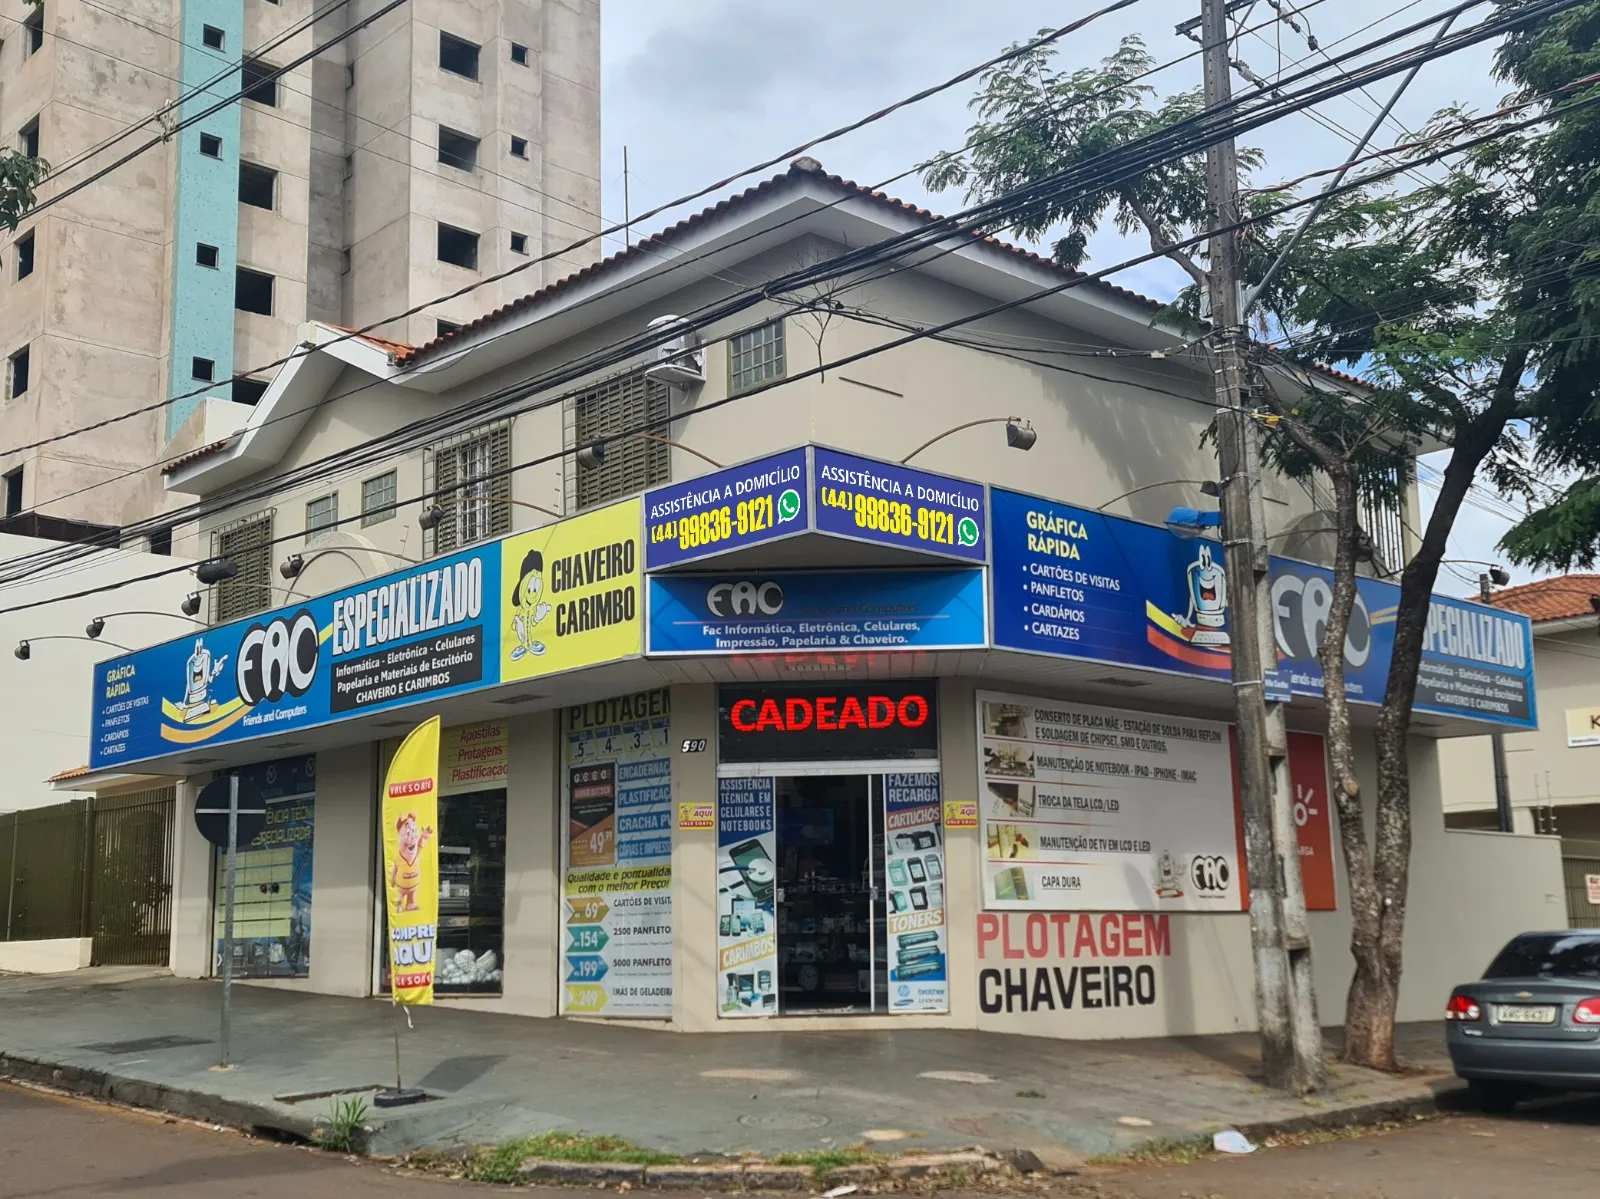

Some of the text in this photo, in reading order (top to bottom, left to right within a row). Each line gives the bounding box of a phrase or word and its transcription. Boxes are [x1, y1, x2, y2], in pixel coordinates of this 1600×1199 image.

[651, 465, 800, 519] ASSISTÊNCIA A DOMICÍLIO
[821, 465, 979, 511] ASSISTÊNCIA A DOMICÍLIO
[651, 495, 773, 550] (44) 99836-9121
[821, 487, 954, 545] (44) 99836-9121
[1026, 511, 1088, 540] GRÁFICA
[1028, 531, 1080, 560] RÁPIDA
[551, 539, 635, 594] CHAVEIRO
[1030, 563, 1120, 591] CARTÕES DE VISITAS
[707, 581, 784, 617] FAC
[1031, 581, 1084, 601] PANFLETOS
[332, 557, 482, 656] ESPECIALIZADO
[556, 585, 635, 637] CARIMBO
[1031, 603, 1085, 623] CARDÁPIOS
[702, 621, 921, 636] Fac Informática, Eletrônica, Celulares,
[1032, 622, 1080, 640] CARTAZES
[1422, 601, 1526, 670] PECIALIZADO
[715, 633, 908, 649] Impressão, Papelaria & Chaveiro.
[237, 614, 319, 704] FAC
[335, 634, 475, 678] Informática Eletrônica Celulares
[106, 664, 136, 683] GRÁFICA
[337, 650, 473, 694] Papelaria e Materiais de Escritório
[105, 682, 131, 699] RÁPIDA
[356, 671, 450, 704] CHAVEIRO E CARIMBOS
[104, 714, 130, 728] PANFLETOS
[243, 713, 263, 727] Friends
[275, 705, 307, 720] Computers
[729, 694, 929, 733] CADEADO
[460, 725, 501, 742] Apostilas
[1034, 709, 1221, 742] CONSERTO DE PLACA MÃE ESTAÇÃO DE SOLDA PARA REFLOW
[681, 740, 706, 753] 590
[1035, 727, 1040, 738] E
[1041, 728, 1079, 742] SOLDAGEM
[1080, 732, 1089, 743] DE
[1120, 736, 1135, 748] SMD
[1136, 739, 1141, 749] E
[103, 743, 126, 755] CARTAZES
[619, 760, 671, 780] ENCADERNAÇ
[1037, 756, 1084, 773] MANUTENÇÃO
[1085, 760, 1094, 771] DE
[1095, 761, 1130, 775] NOTEBOOK
[1134, 765, 1149, 777] IPAD
[1154, 767, 1177, 779] IPHONE
[720, 777, 771, 790] ASSISTÊNCIA
[888, 773, 938, 787] FAZEMOS
[390, 785, 407, 795] VALE
[619, 787, 671, 805] PLASTIFICAÇ
[720, 791, 771, 804] TÉCNICA EM
[889, 788, 938, 802] RECARGA
[720, 805, 771, 818] CELULARES E
[1038, 794, 1119, 812] TROCA DA TELA LCD/LED
[619, 815, 658, 831] CRACHA
[693, 810, 713, 818] AQUI
[888, 807, 940, 828] CARTUCHOS
[720, 819, 771, 832] NOTEBOOKS
[1040, 836, 1150, 852] MANUTENÇÃO DE TV EM LCD E LED
[567, 872, 611, 884] Qualidade
[1042, 876, 1081, 888] CAPA DURA
[1191, 855, 1230, 891] FAC
[578, 885, 596, 893] com
[606, 881, 638, 892] melhor
[640, 879, 670, 890] Preço!
[585, 902, 598, 918] 69
[613, 896, 672, 907] CARTÕES DE VISIT
[890, 911, 943, 932] TONERS
[580, 931, 598, 947] 154
[613, 926, 672, 936] 2500 PANFLETO
[976, 912, 1171, 960] PLOTAGEM
[613, 958, 672, 967] 5000 PANFLETO
[723, 941, 775, 968] CARIMBOS
[579, 961, 598, 977] 199
[579, 990, 597, 1006] 249
[629, 987, 638, 996] DE
[978, 964, 1156, 1014] CHAVEIRO
